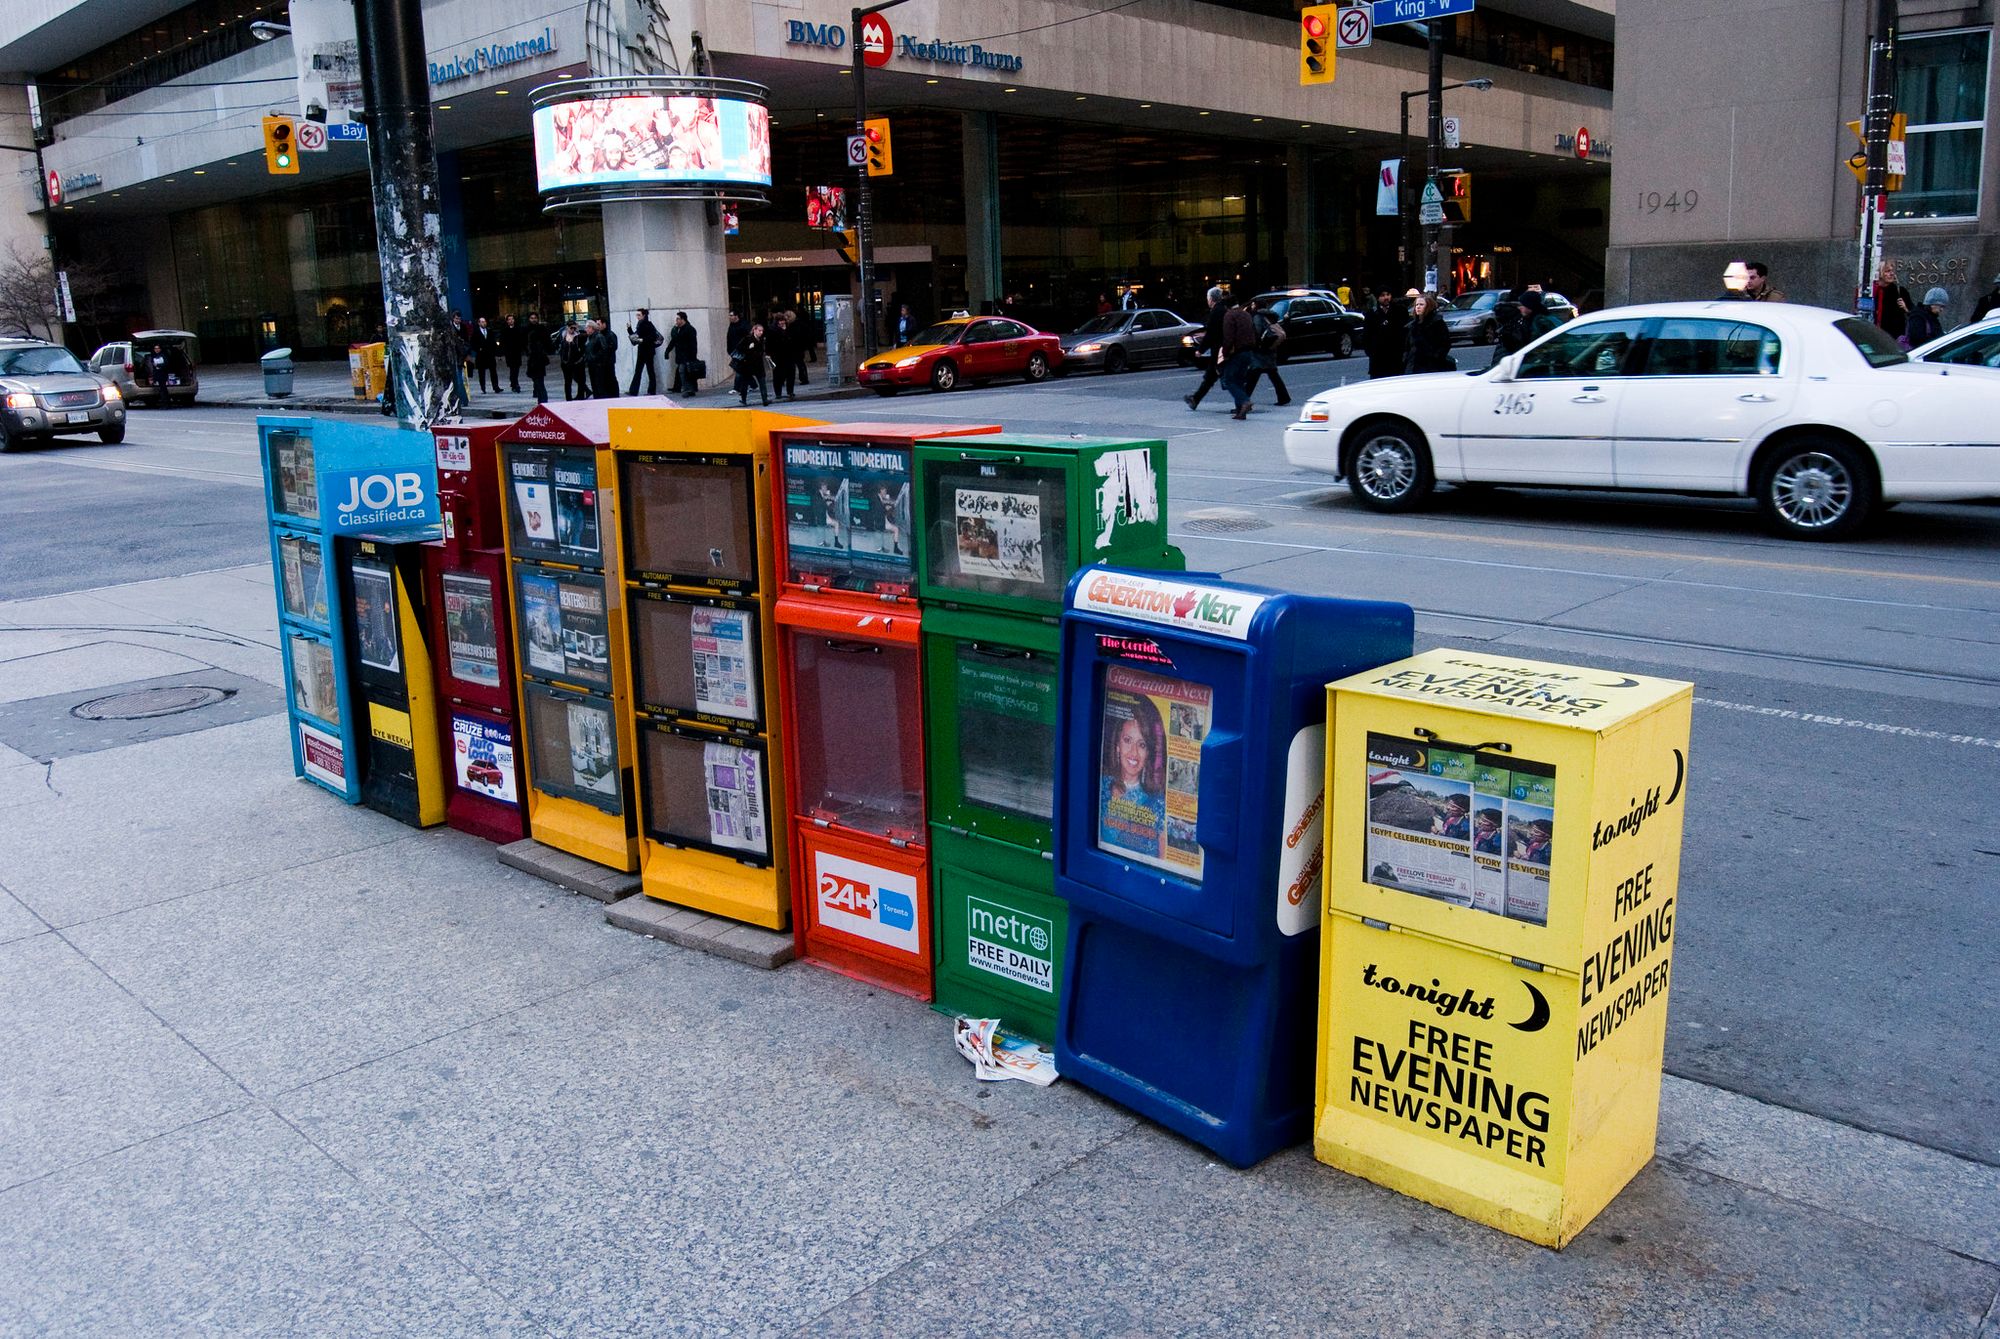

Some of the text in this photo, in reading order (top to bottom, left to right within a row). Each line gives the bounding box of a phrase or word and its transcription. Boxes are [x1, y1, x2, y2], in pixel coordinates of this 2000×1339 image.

[1395, 0, 1425, 17] King
[787, 19, 845, 48] BMO
[430, 27, 553, 85] Bank of Montreal
[900, 34, 1023, 71] Nesbitt Burns
[342, 124, 363, 140] Bay
[1638, 189, 1699, 214] 1949
[1897, 258, 1968, 271] BANK OF
[1908, 272, 1967, 284] SCOTIA
[713, 458, 728, 466] FREE
[981, 465, 996, 476] PULL
[337, 472, 425, 513] JOB
[338, 508, 426, 526] Classified.ca
[361, 541, 376, 555] FREE
[642, 572, 672, 582] AUTOMART
[707, 578, 740, 588] AUTOMART
[648, 592, 662, 600] FREE
[721, 600, 736, 608] FREE
[1088, 575, 1175, 614] GENERATION
[1193, 593, 1242, 626] NEXT
[1102, 637, 1120, 648] The
[1108, 667, 1209, 701] Generation Next
[1391, 670, 1608, 710] EVENING
[1467, 672, 1558, 691] FREE
[1371, 678, 1588, 717] NEWSPAPER
[645, 703, 679, 716] TRUCK MART
[453, 721, 483, 738] CRUZE
[657, 724, 671, 733] FREE
[697, 713, 755, 730] EMPLOYMENT NEWS
[373, 728, 411, 747] EYE WEEKLY
[470, 736, 495, 753] AUTO
[729, 738, 744, 747] FREE
[1371, 827, 1470, 853] EGYPT CELEBRATES VICTORY
[1426, 872, 1456, 884] FEBRUARY
[1614, 863, 1654, 923] FREE
[883, 904, 909, 917] Toronto
[971, 905, 1049, 950] metro
[970, 940, 1051, 978] FREE DAILY
[1581, 897, 1673, 1008] EVENING
[970, 956, 1050, 988] www.metronews.ca
[1577, 959, 1669, 1062] NEWSPAPER
[1409, 1020, 1493, 1073] FREE
[1353, 1036, 1550, 1133] EVENING
[1350, 1076, 1546, 1168] NEWSPAPER
